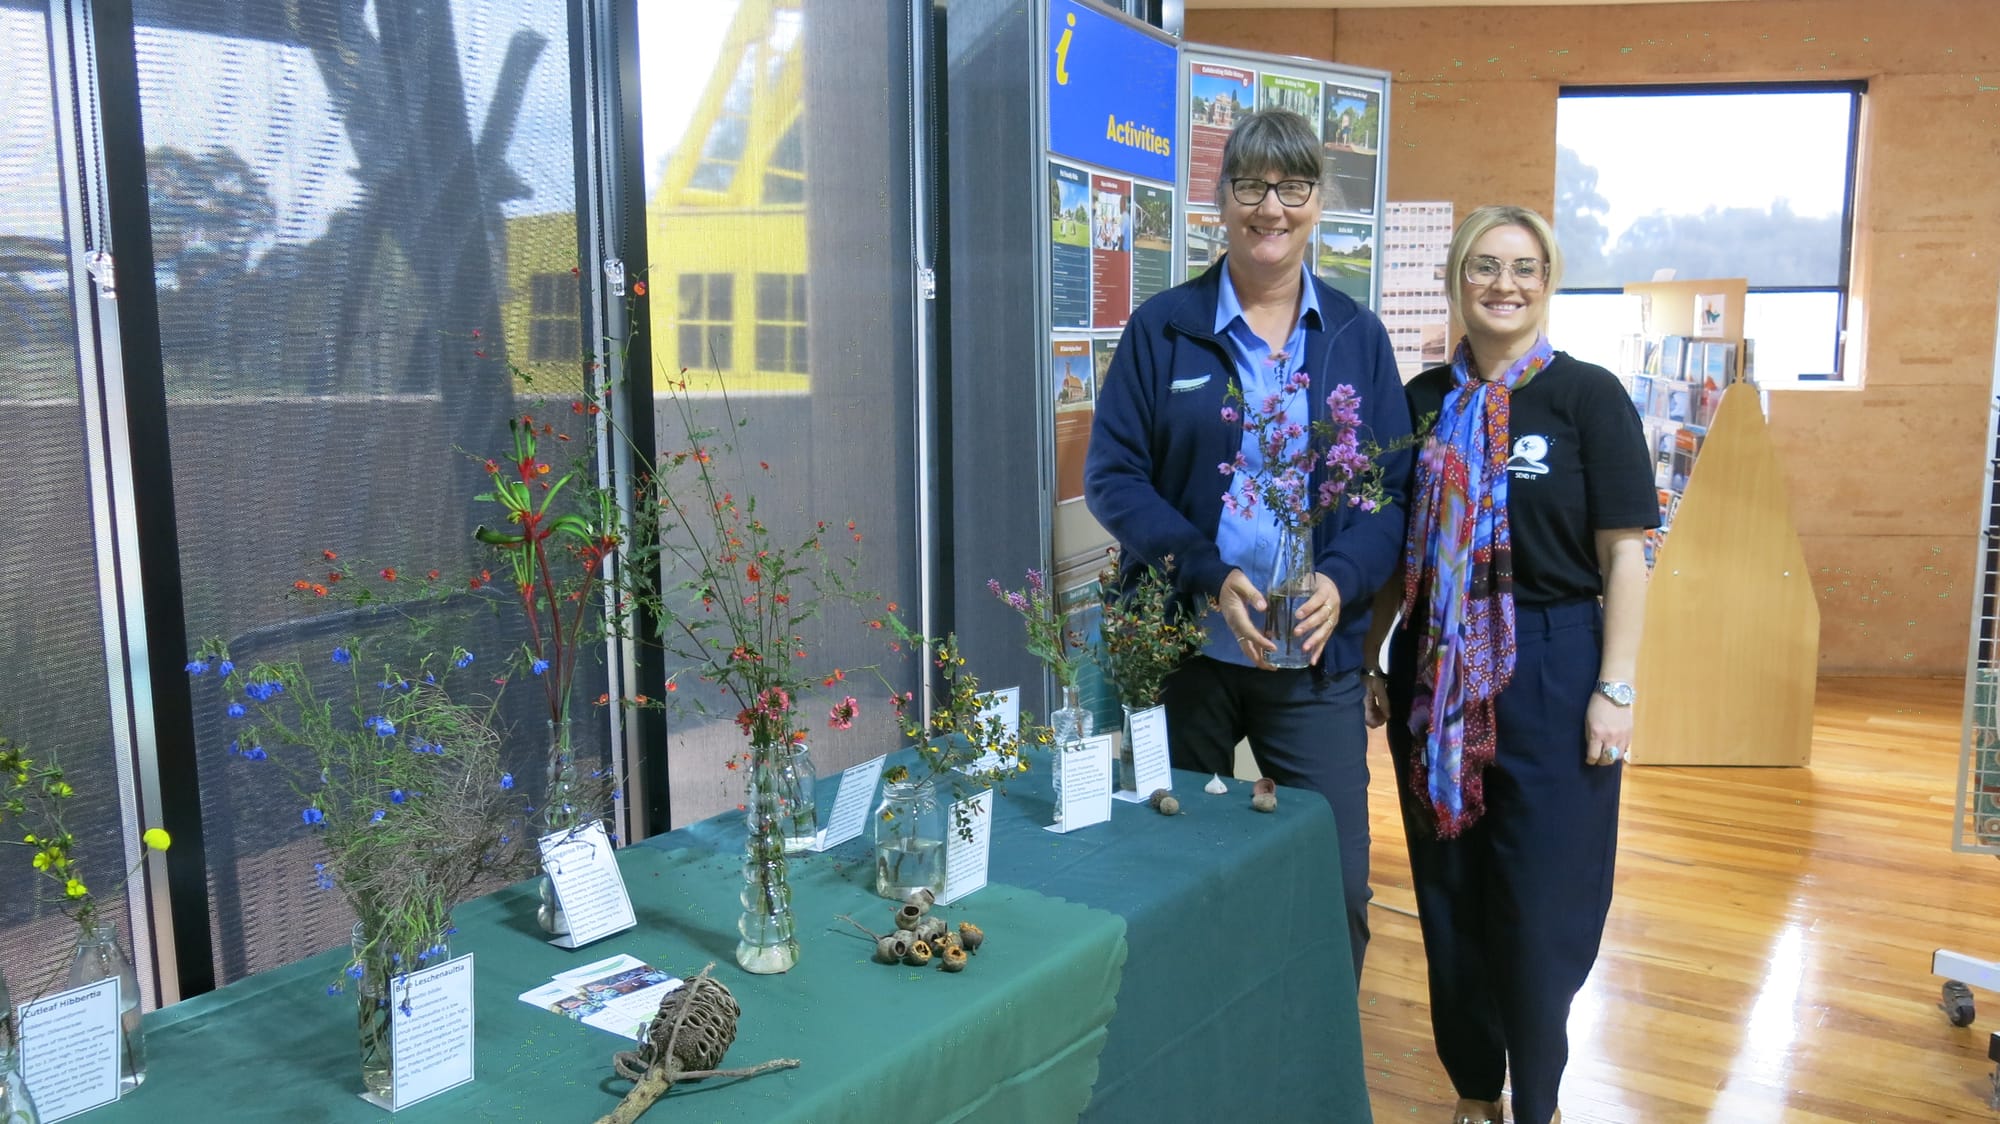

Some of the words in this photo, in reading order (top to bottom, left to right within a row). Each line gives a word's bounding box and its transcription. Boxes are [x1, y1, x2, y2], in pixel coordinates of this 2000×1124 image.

[1056, 12, 1076, 85] i
[1106, 113, 1170, 157] Activities
[414, 965, 465, 987] Leschenaultia
[24, 1003, 58, 1019] Cutleaf
[59, 990, 102, 1008] Hibbertia
